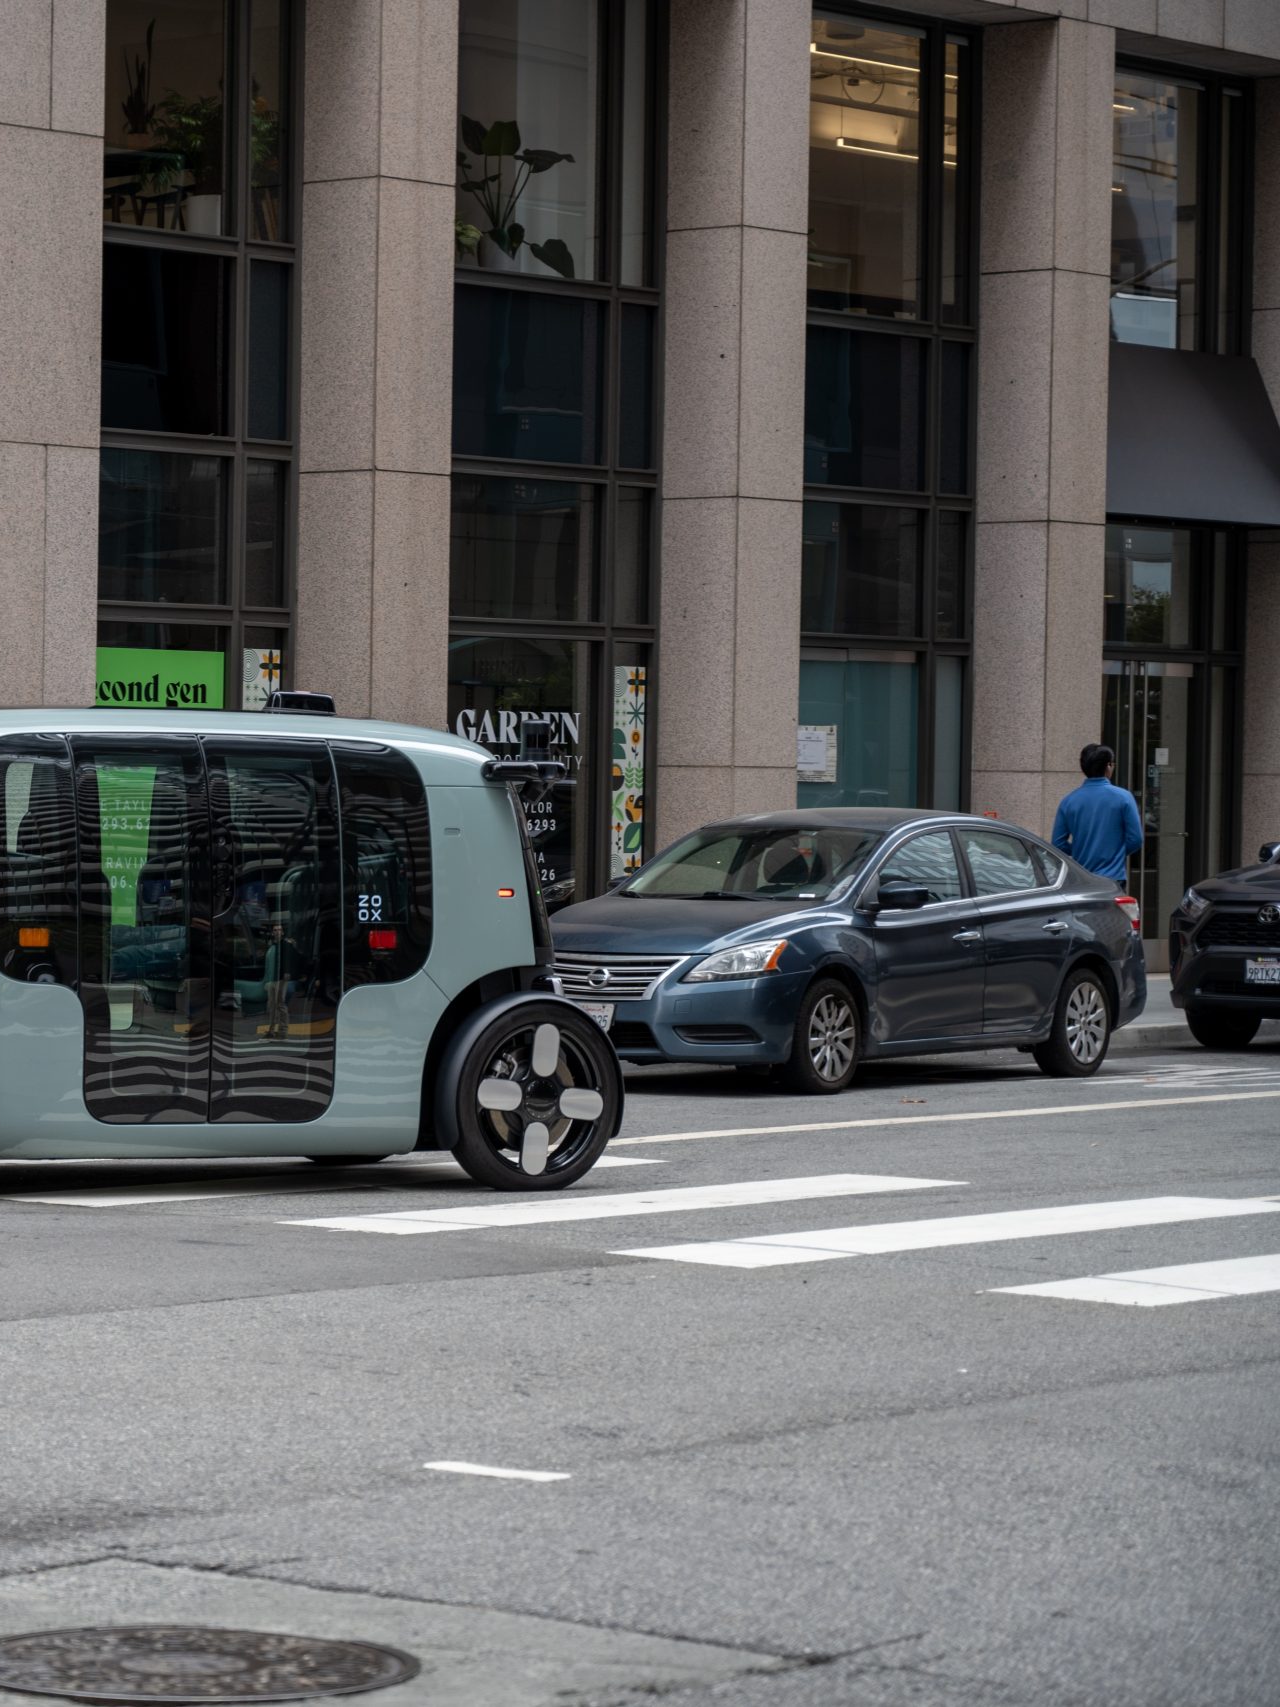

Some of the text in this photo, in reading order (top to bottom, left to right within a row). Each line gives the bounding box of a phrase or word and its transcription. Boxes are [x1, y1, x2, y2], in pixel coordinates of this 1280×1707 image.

[96, 674, 208, 708] cond gen
[115, 800, 151, 811] TAYL
[523, 802, 553, 814] YLOR
[527, 819, 556, 831] 6293
[111, 876, 137, 889] 06.
